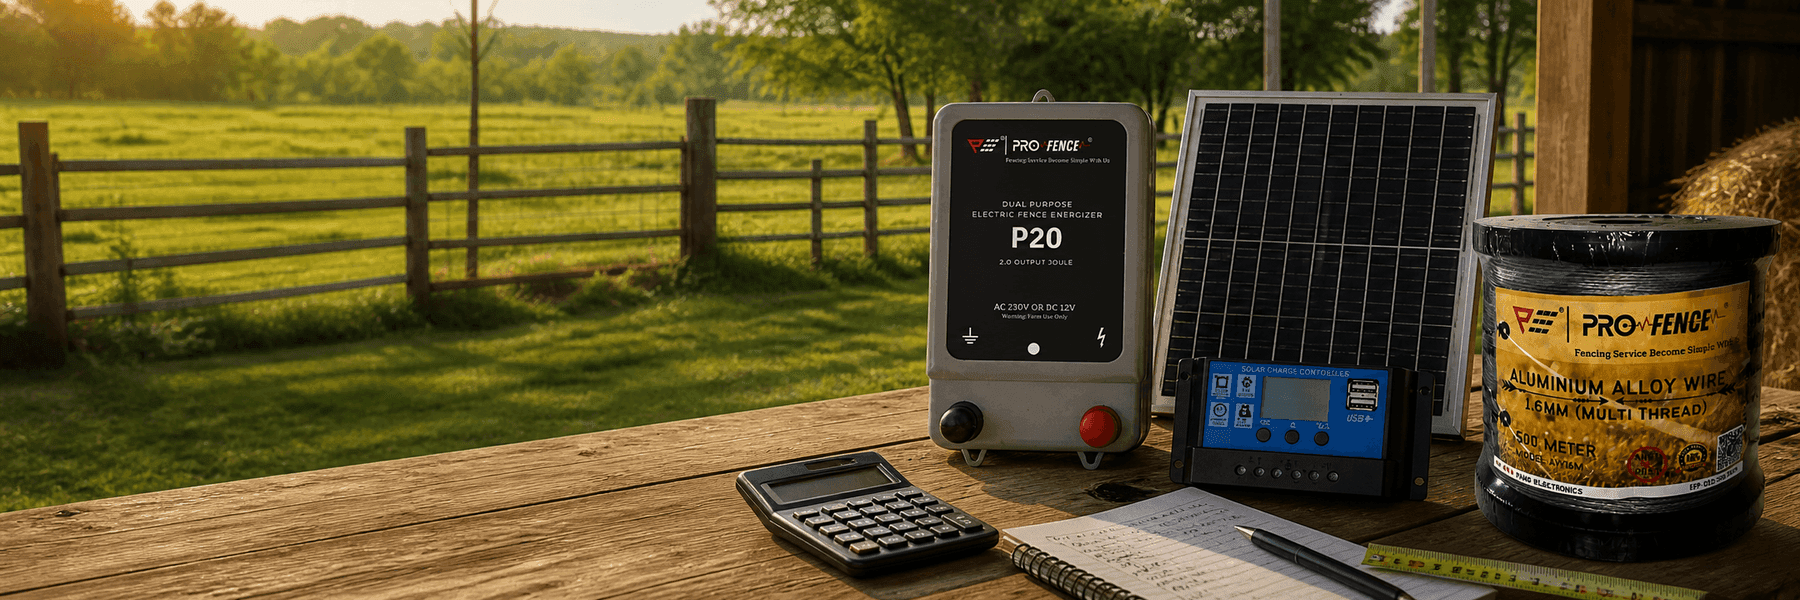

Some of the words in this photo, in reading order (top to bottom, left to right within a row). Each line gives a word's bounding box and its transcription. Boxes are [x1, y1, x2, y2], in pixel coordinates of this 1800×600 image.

[1012, 139, 1040, 152] PRO
[1046, 139, 1080, 152] FENCE
[1017, 211, 1047, 219] FENCE
[1050, 211, 1103, 219] ENERGIZER
[1011, 226, 1062, 249] P20
[994, 303, 1006, 311] AC
[1007, 303, 1030, 311] 230V
[1031, 303, 1045, 311] OR
[1046, 303, 1058, 311] DC
[1060, 304, 1076, 312] 12V
[1582, 313, 1636, 337] PRO
[1650, 308, 1712, 337] FENCE
[1574, 348, 1612, 360] Fencing
[1613, 349, 1648, 358] Service
[1649, 348, 1686, 358] Become
[1509, 368, 1604, 396] ALUMINIUM
[1611, 377, 1677, 395] ALLOY
[1683, 370, 1727, 392] WIRE
[1525, 397, 1569, 418] 1.6MM
[1575, 404, 1632, 421] (MULTI
[1638, 400, 1708, 421] THREAD)
[1543, 438, 1596, 458] METER
